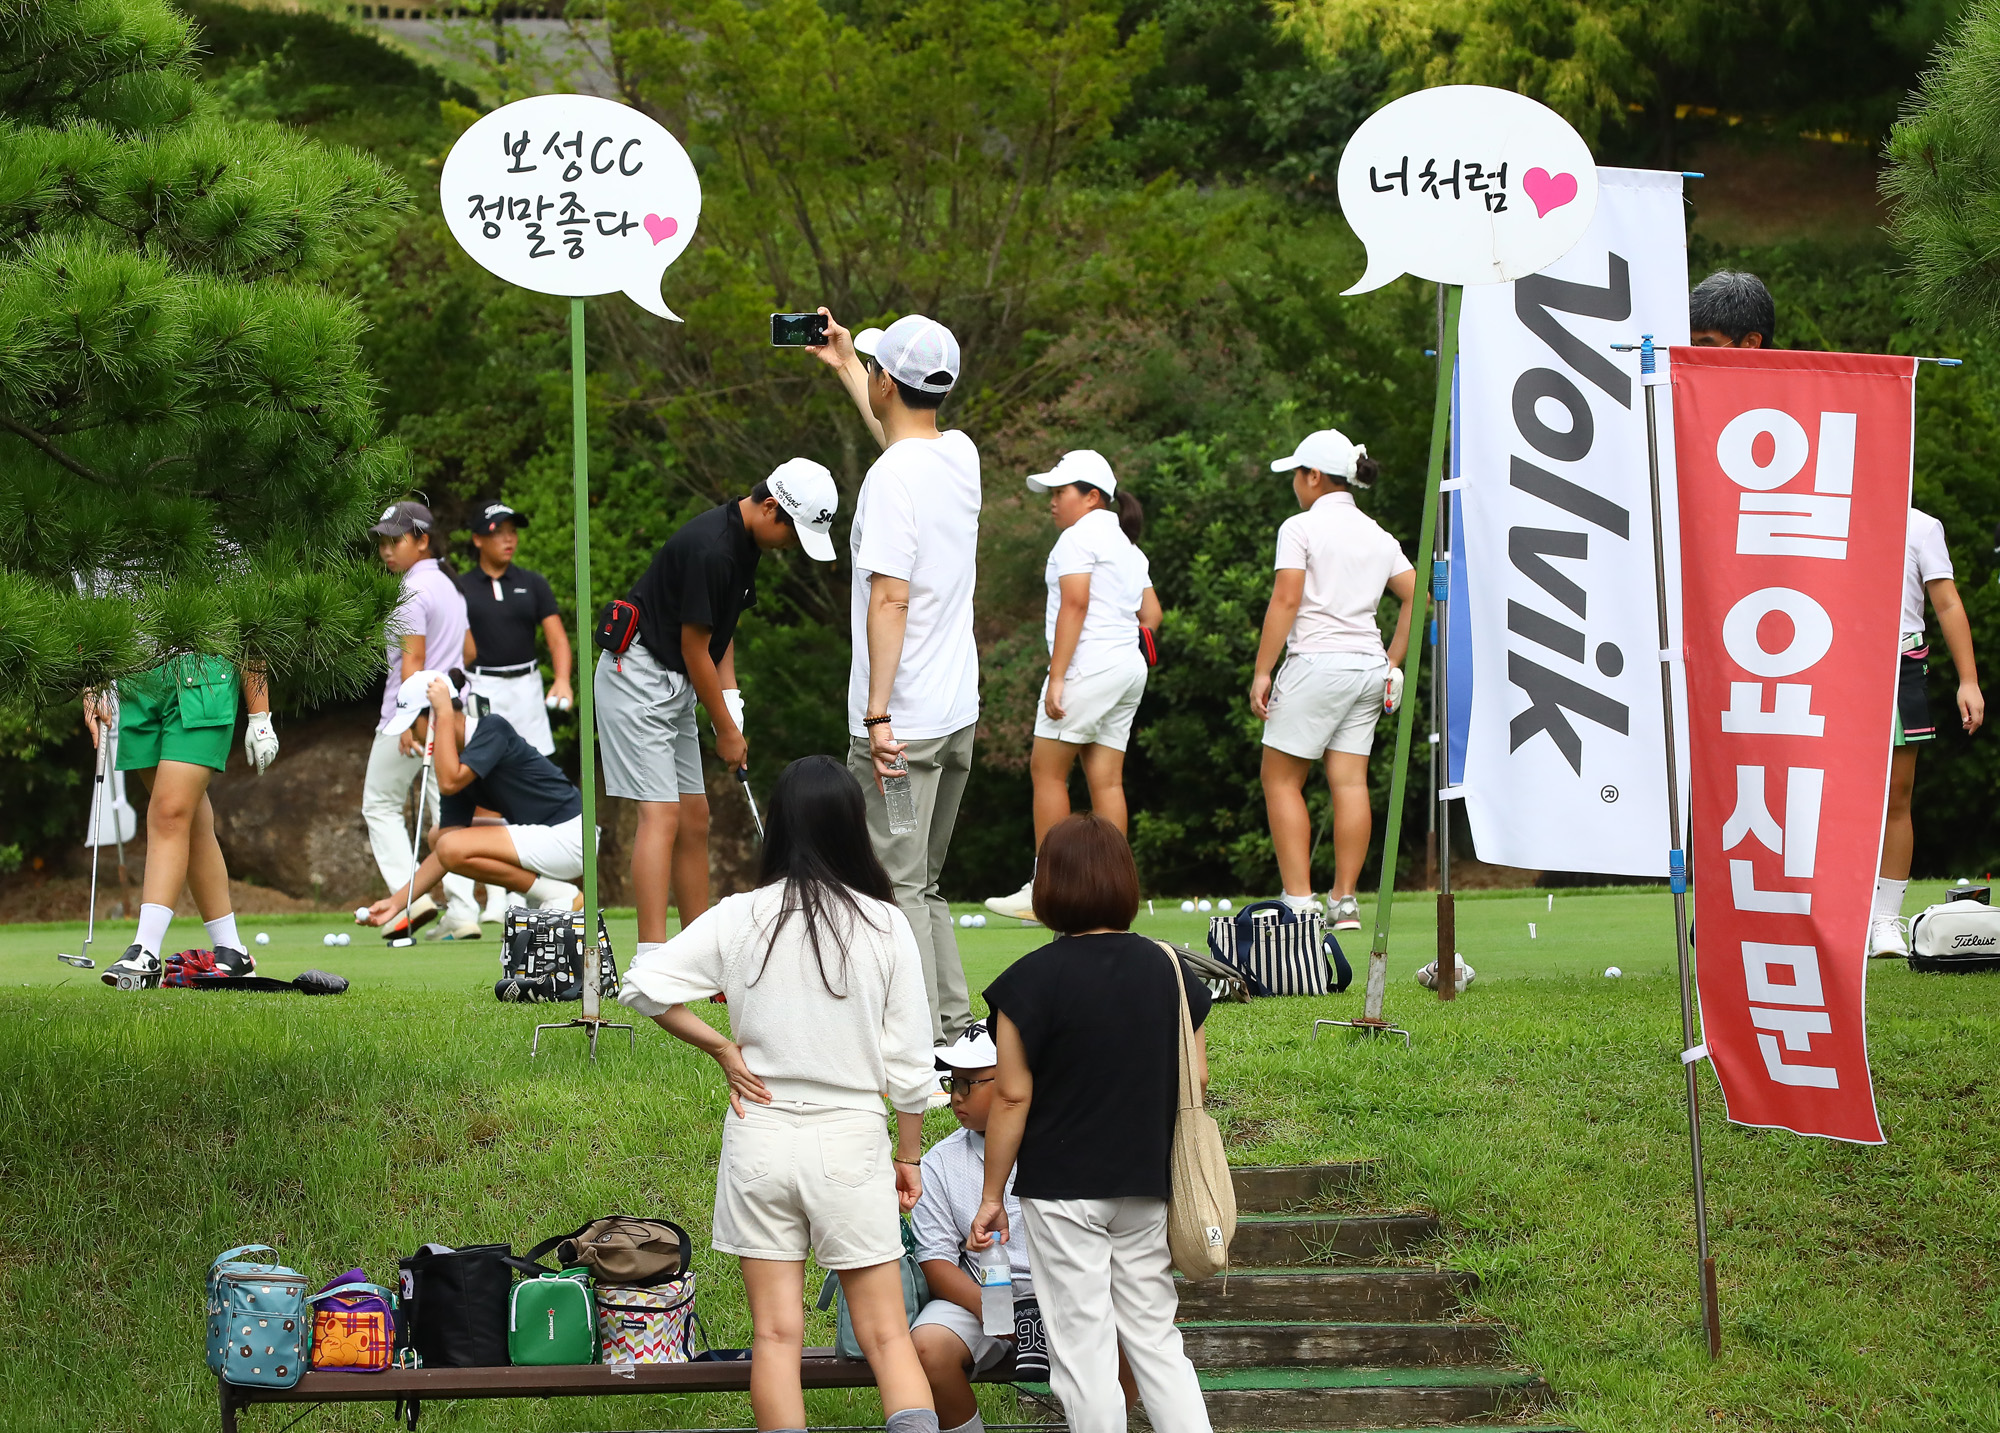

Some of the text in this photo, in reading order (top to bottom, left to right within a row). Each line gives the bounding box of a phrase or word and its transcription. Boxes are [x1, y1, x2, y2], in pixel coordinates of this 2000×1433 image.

[503, 130, 643, 182] 보성CC
[1369, 155, 1508, 214] 너처럼
[775, 481, 802, 508] Cleveland
[1508, 250, 1632, 778] Volvik
[1715, 408, 1857, 1089] 일요신문
[1951, 933, 1996, 949] Titleist
